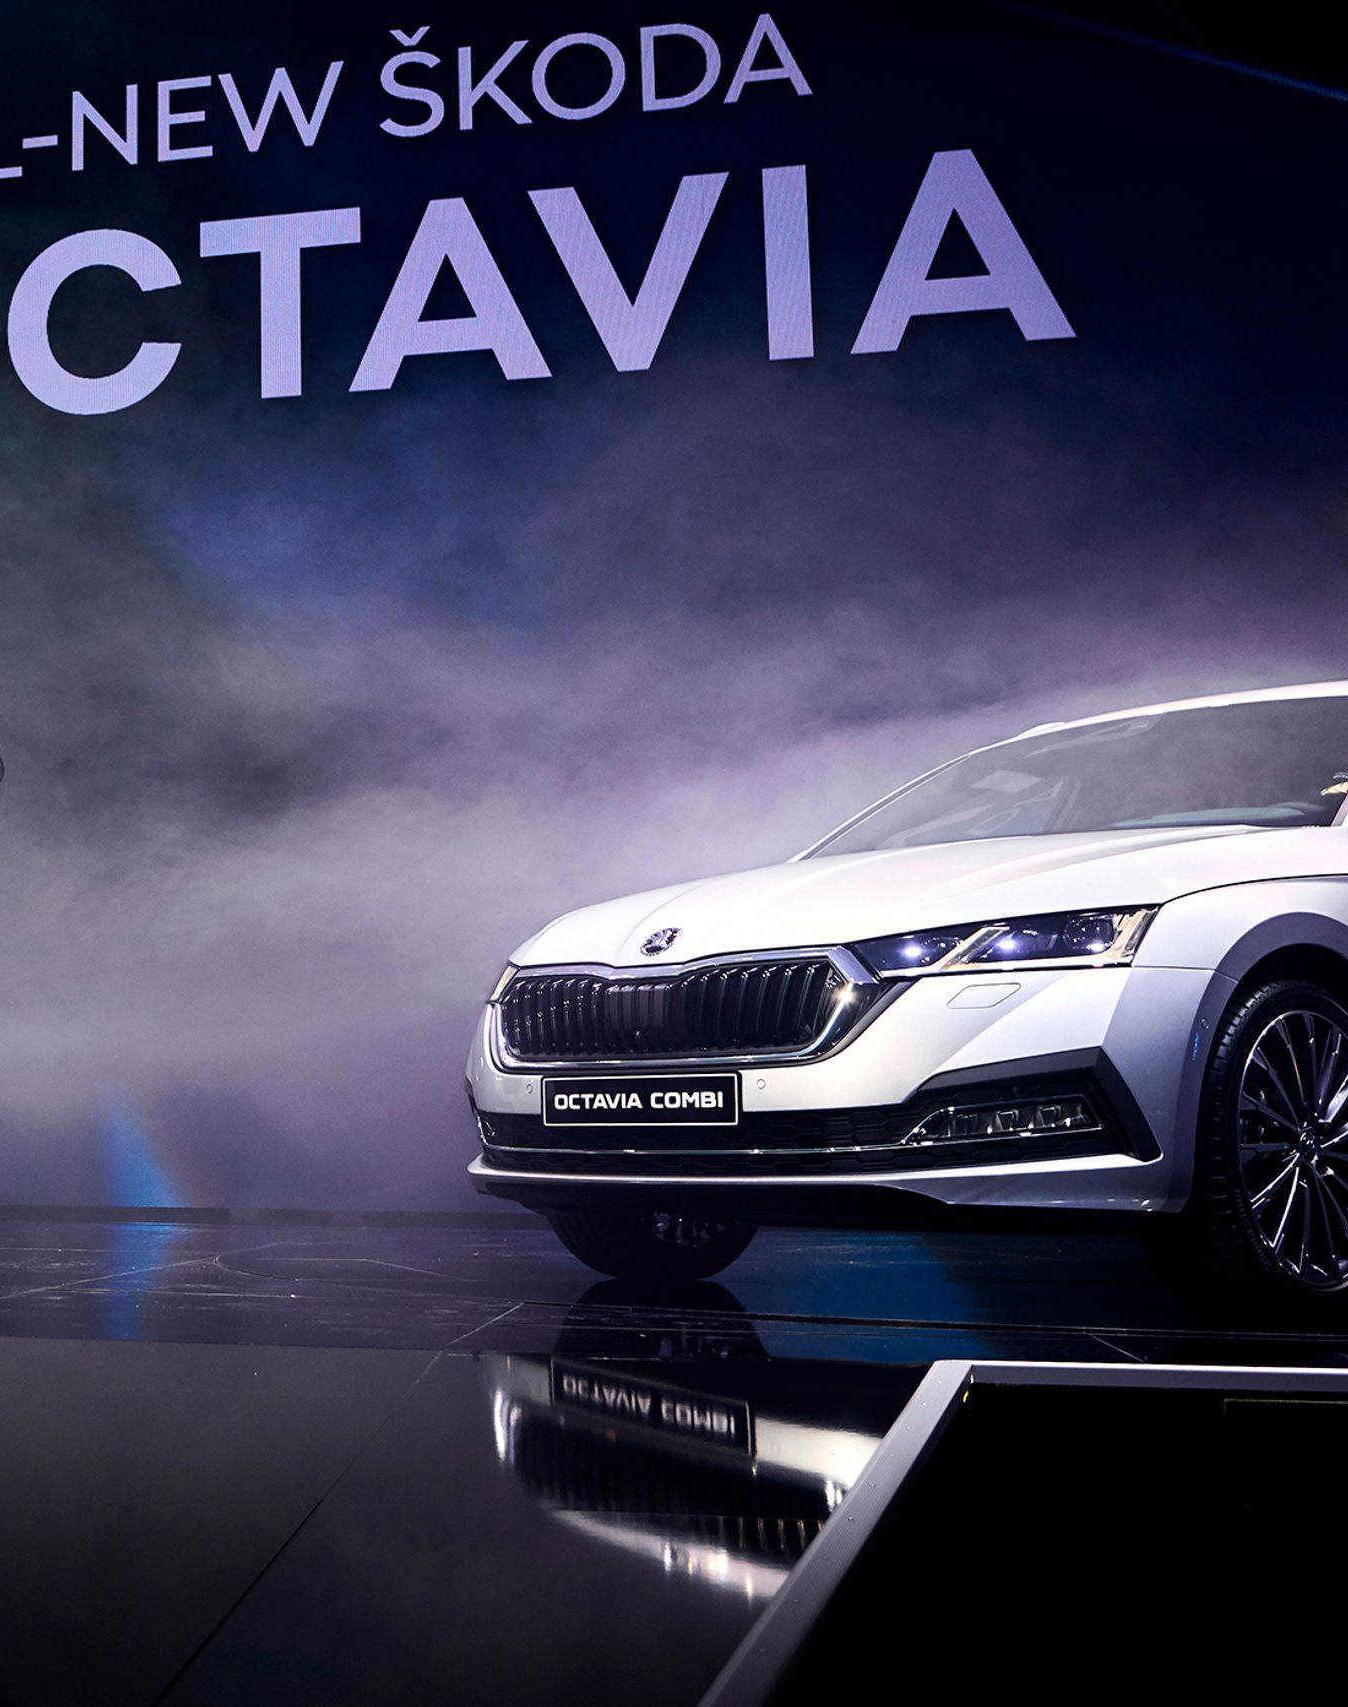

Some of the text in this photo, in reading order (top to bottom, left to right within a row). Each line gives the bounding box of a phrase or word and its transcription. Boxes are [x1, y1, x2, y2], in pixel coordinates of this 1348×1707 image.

[378, 13, 813, 137] ŠKODA
[554, 1091, 724, 1110] OCTAVIA COMBI
